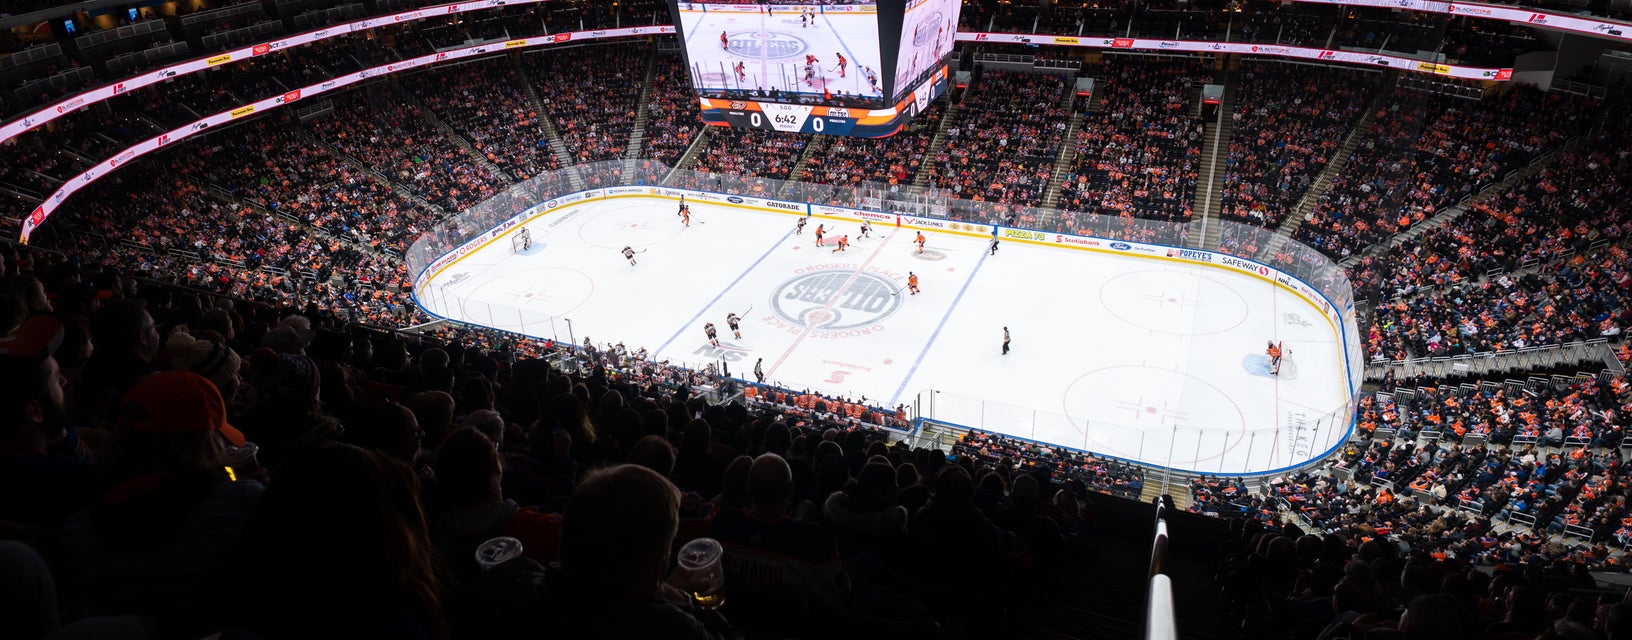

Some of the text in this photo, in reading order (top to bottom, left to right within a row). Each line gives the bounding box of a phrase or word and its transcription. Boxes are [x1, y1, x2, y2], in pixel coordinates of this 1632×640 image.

[729, 39, 799, 52] OILERS
[910, 102, 915, 117] 0
[751, 112, 761, 127] 0
[775, 114, 796, 124] 6:42
[813, 118, 824, 132] 0
[767, 201, 800, 210] GATORADE
[854, 211, 890, 219] chemco
[1005, 229, 1045, 240] PIZZA 73
[1065, 237, 1100, 246] Scotiabank
[466, 236, 487, 251] ROGERS
[1179, 249, 1212, 260] POPEYE'S
[1222, 257, 1259, 271] SAFEWAY
[806, 263, 905, 280] ROGERS PLACE
[1278, 277, 1298, 290] NHL.com
[763, 314, 873, 339] ROGERS PLACE
[822, 358, 872, 372] Scotiabank
[1294, 412, 1308, 458] THE KEG
